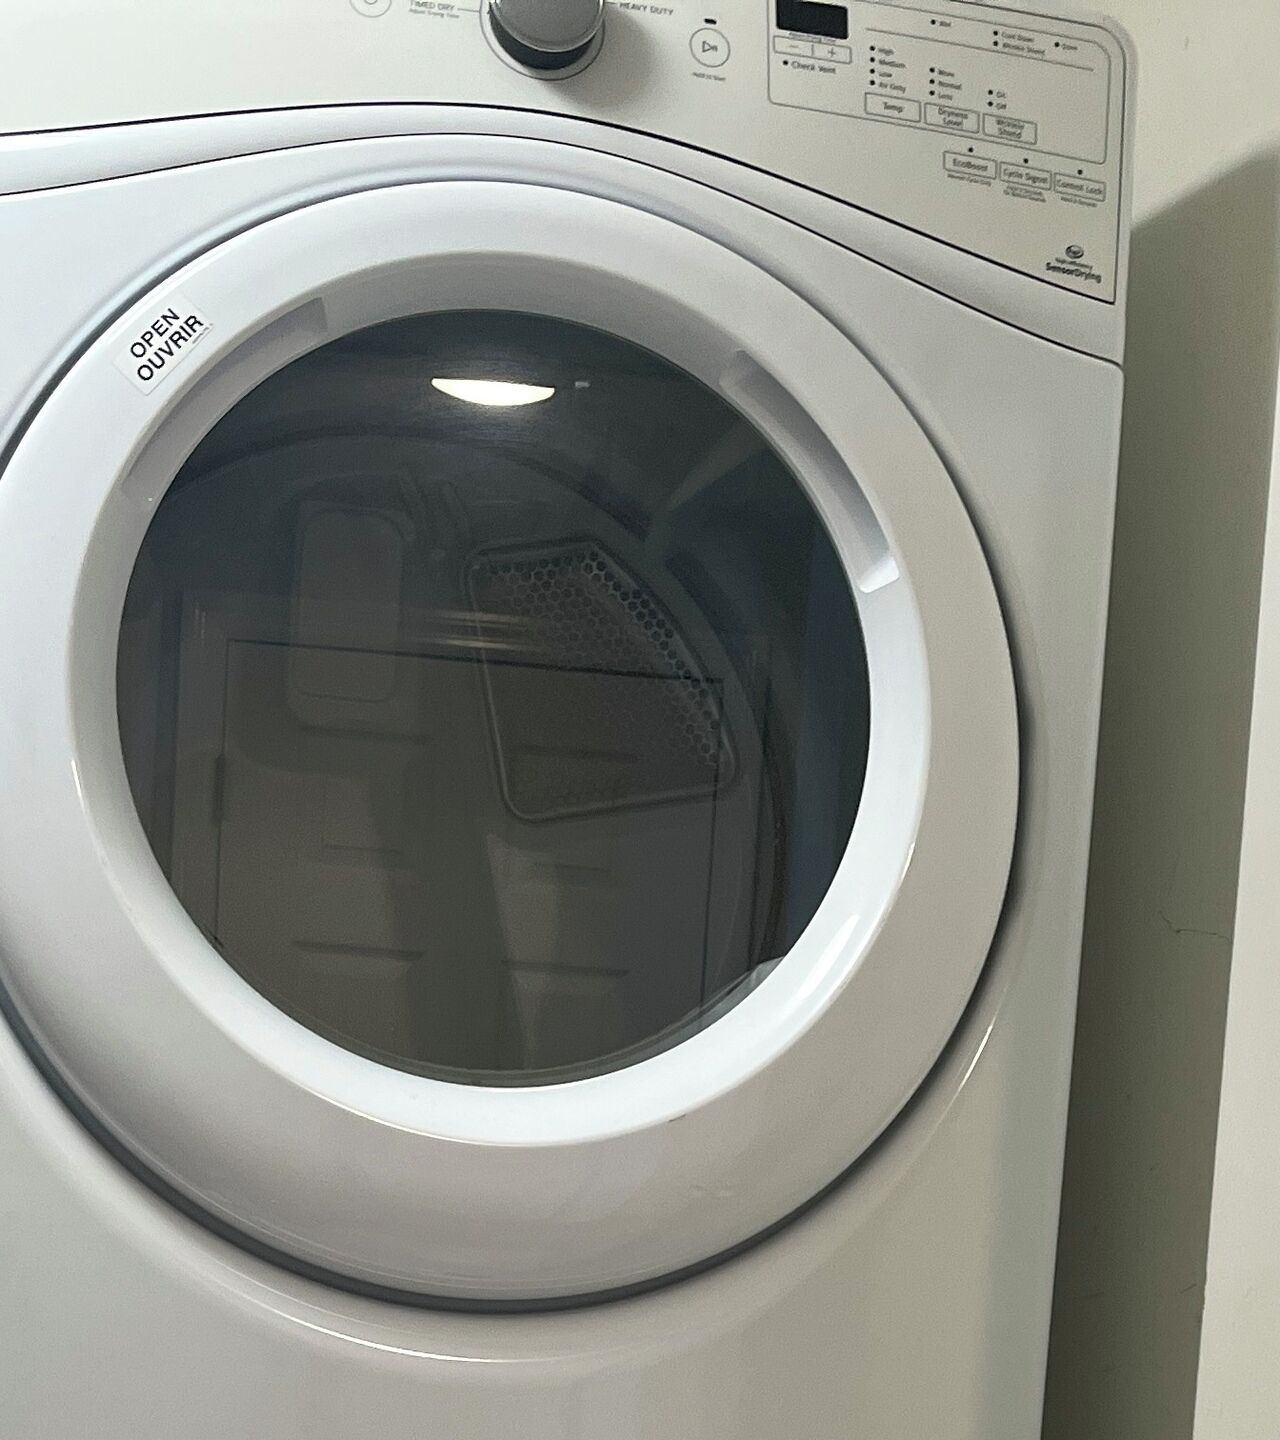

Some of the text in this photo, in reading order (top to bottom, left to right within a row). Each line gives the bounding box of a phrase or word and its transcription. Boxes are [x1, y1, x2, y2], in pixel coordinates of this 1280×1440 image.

[650, 5, 674, 16] DUTY
[791, 60, 816, 71] Check
[883, 101, 905, 114] Temp
[130, 308, 180, 358] OPEN
[137, 315, 204, 381] OUVRIR
